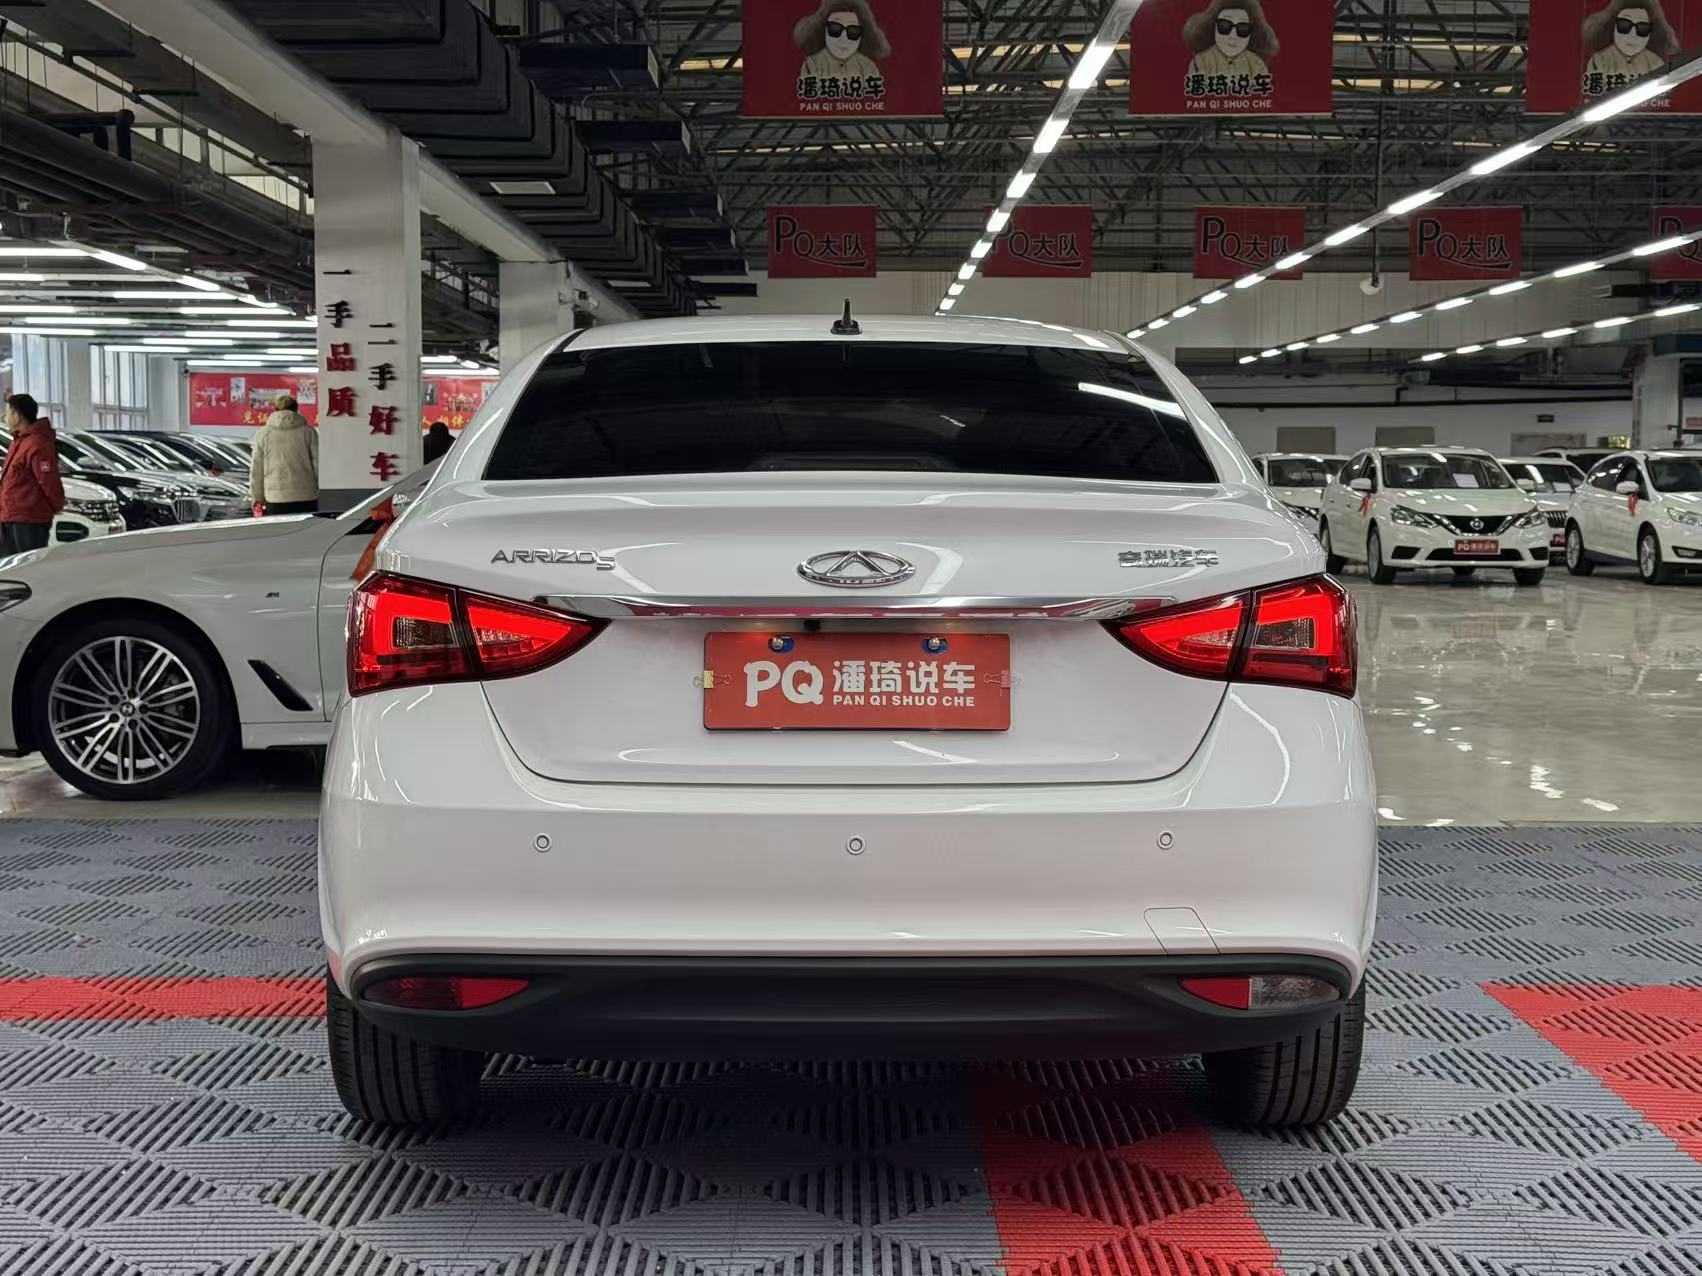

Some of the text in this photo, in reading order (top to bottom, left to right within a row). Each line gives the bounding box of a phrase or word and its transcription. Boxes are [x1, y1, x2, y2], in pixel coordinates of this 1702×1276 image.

[797, 75, 885, 98] 潘琦说车
[1184, 73, 1273, 97] 潘琦说车
[800, 102, 885, 111] PAN QI SHUO CHE
[1186, 100, 1272, 109] PAN QI SHUO CHE
[322, 269, 357, 417] 一手品质
[367, 322, 401, 482] 二手好车
[744, 660, 824, 708] PQ
[832, 660, 976, 694] 潘琦说车
[832, 695, 975, 707] PAN QI SHUO CHE
